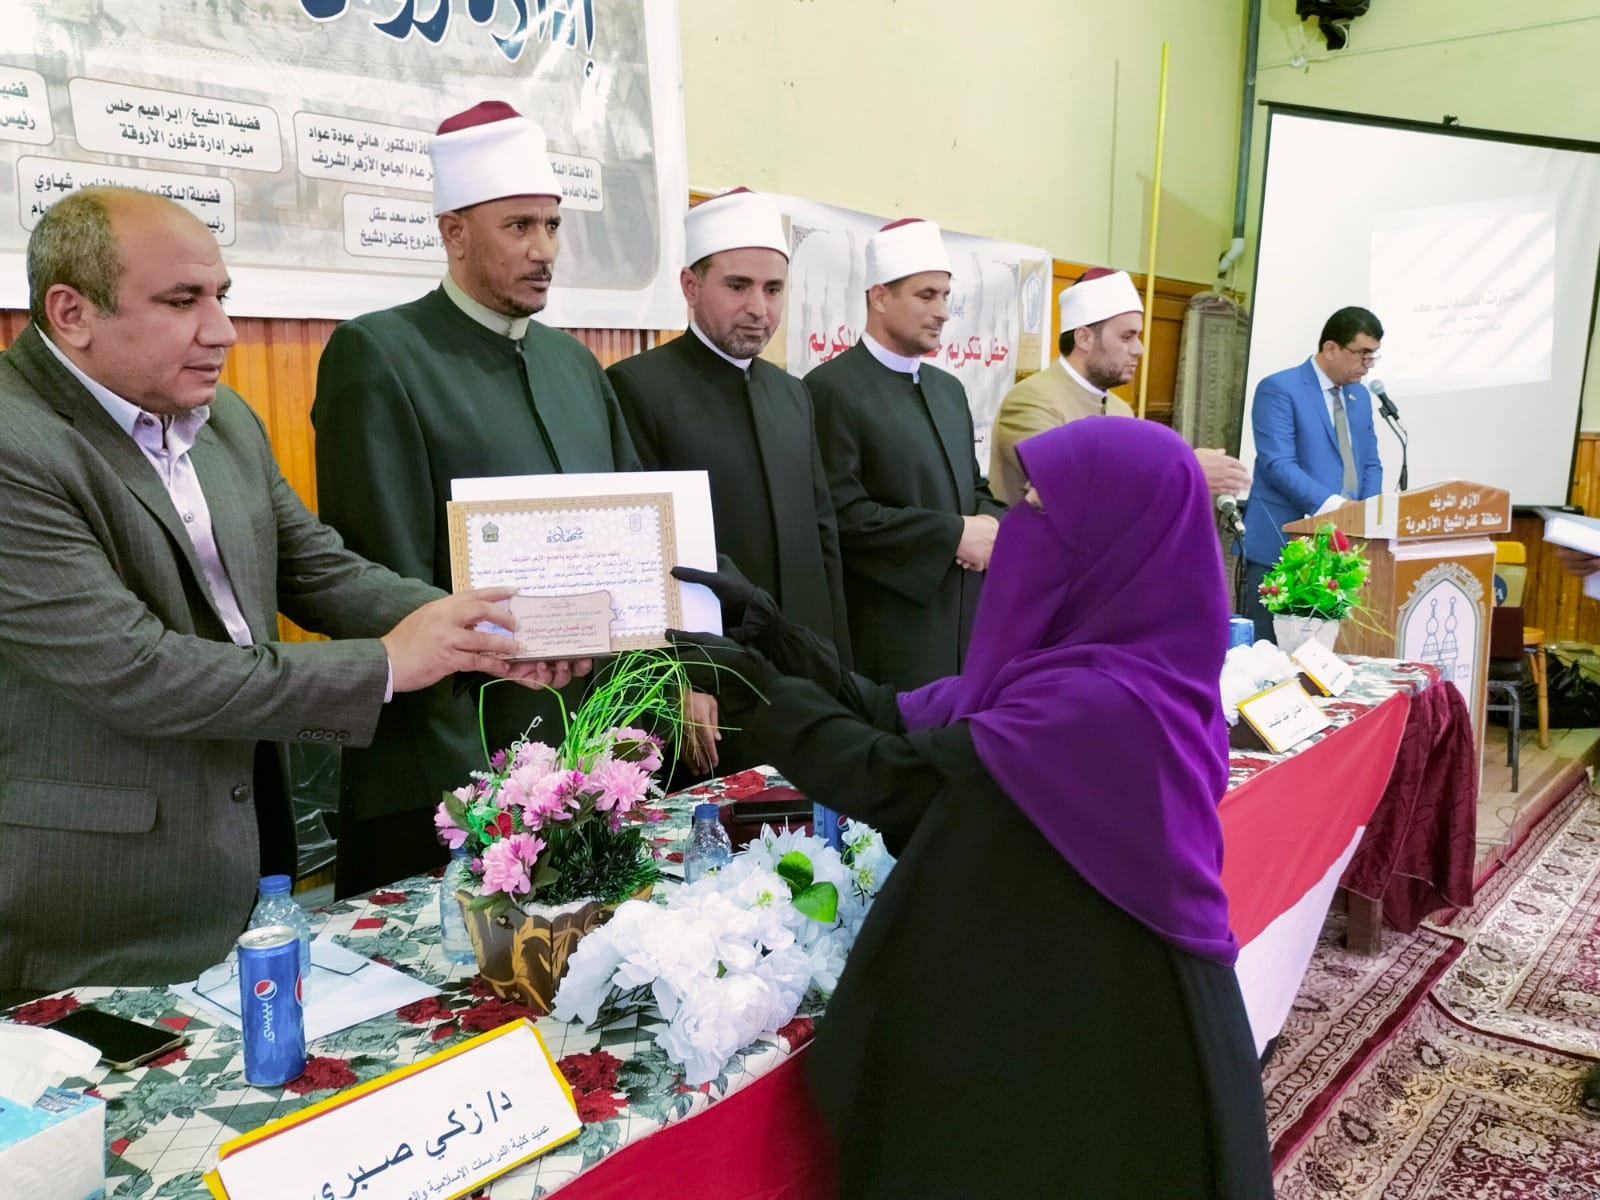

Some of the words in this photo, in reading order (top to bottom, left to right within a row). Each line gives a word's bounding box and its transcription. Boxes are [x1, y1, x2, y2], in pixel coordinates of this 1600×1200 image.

[106, 99, 133, 114] حلس
[137, 102, 183, 122] إبراهيم
[228, 113, 261, 132] فضيلة
[120, 123, 164, 146] الأروقة
[168, 130, 199, 149] شؤون
[308, 126, 330, 142] عواد
[332, 128, 354, 144] عودة
[356, 132, 379, 151] هاني
[200, 136, 226, 155] إدارة
[229, 142, 255, 157] مدير
[311, 150, 351, 169] الشريف
[351, 155, 379, 173] الأزهر
[380, 161, 408, 177] الجامع
[34, 172, 73, 192] شهاوي
[409, 166, 425, 179] عام
[190, 187, 222, 207] فضيلة
[368, 206, 388, 223] عقل
[389, 210, 407, 223] سعد
[409, 211, 431, 225] أحمد
[359, 228, 387, 247] الشيخ
[387, 231, 409, 250] بكفر
[409, 234, 439, 250] الفروع
[945, 335, 982, 369] تكريم
[984, 336, 1008, 367] حفل
[1429, 492, 1457, 512] الشريف
[1458, 491, 1480, 510] الأزهر
[1404, 514, 1441, 534] الأزهرية
[1443, 513, 1465, 533] الشيخ
[1463, 513, 1479, 530] كفر
[1480, 511, 1503, 526] منطقة
[425, 1101, 483, 1161] زكي
[532, 1124, 550, 1141] عميد
[511, 1134, 530, 1152] كلية
[471, 1143, 511, 1172] الدراسات
[428, 1166, 470, 1194] الإسلامية
